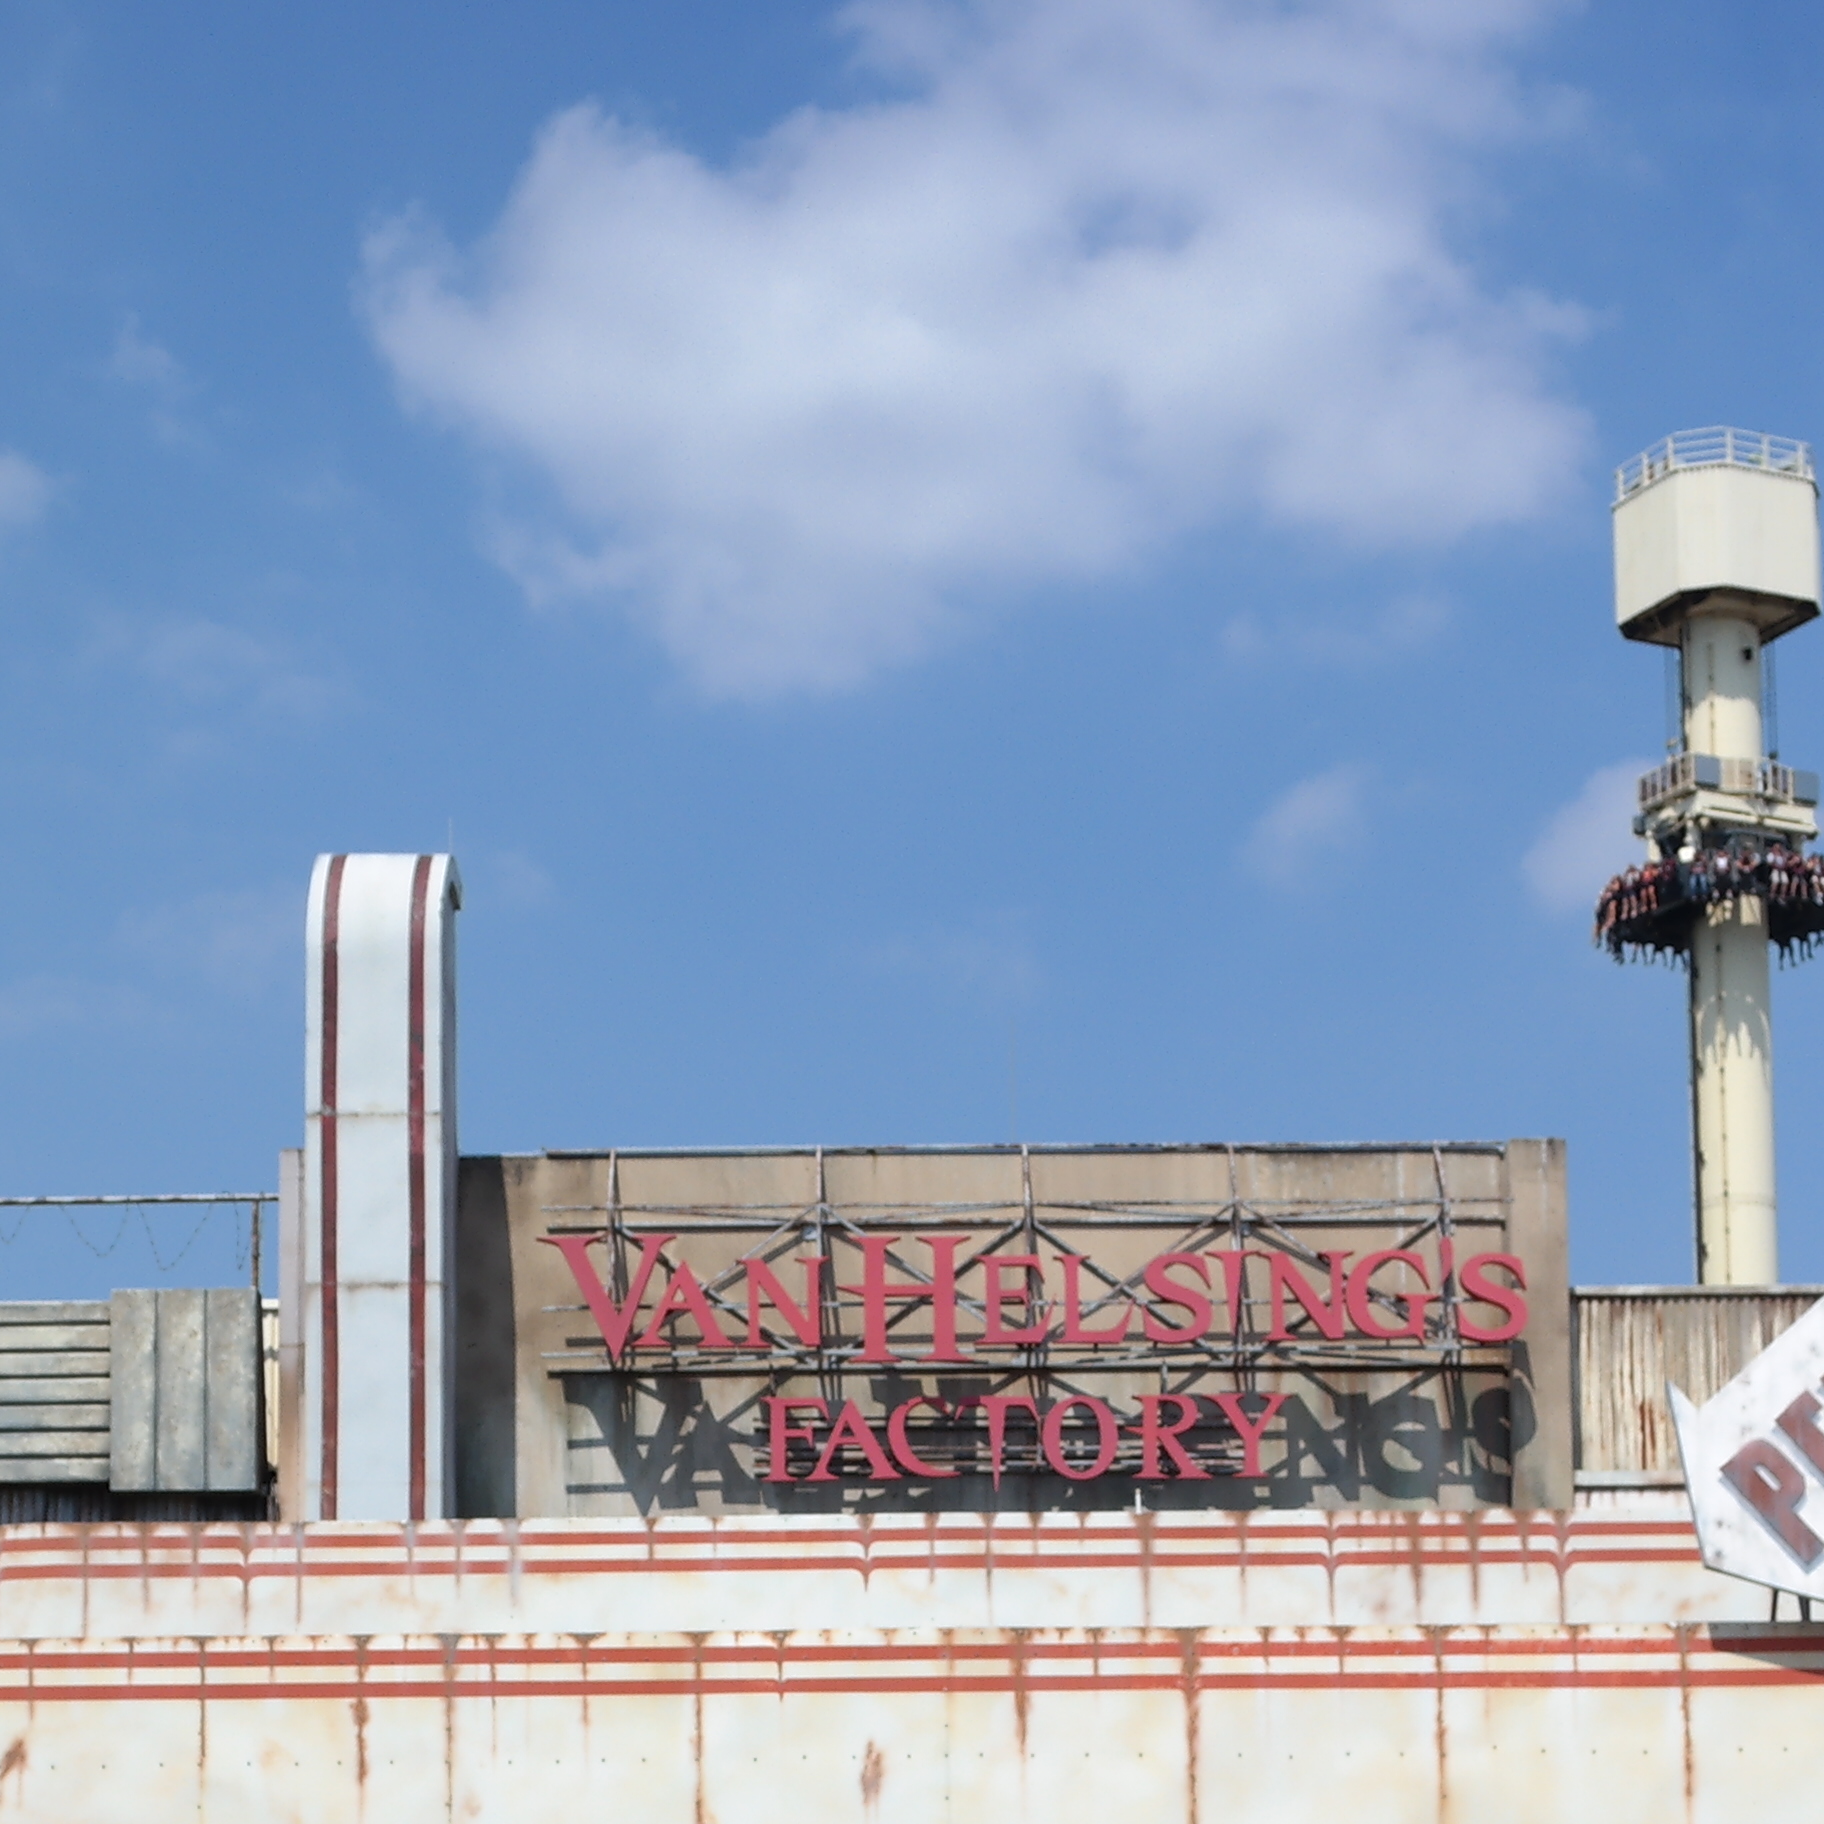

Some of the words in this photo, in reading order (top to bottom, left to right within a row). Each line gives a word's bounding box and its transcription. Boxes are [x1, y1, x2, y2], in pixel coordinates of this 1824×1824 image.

[537, 1233, 831, 1364] VAN
[837, 1233, 1529, 1364] HELSING'S
[760, 1391, 1292, 1493] FACTORY
